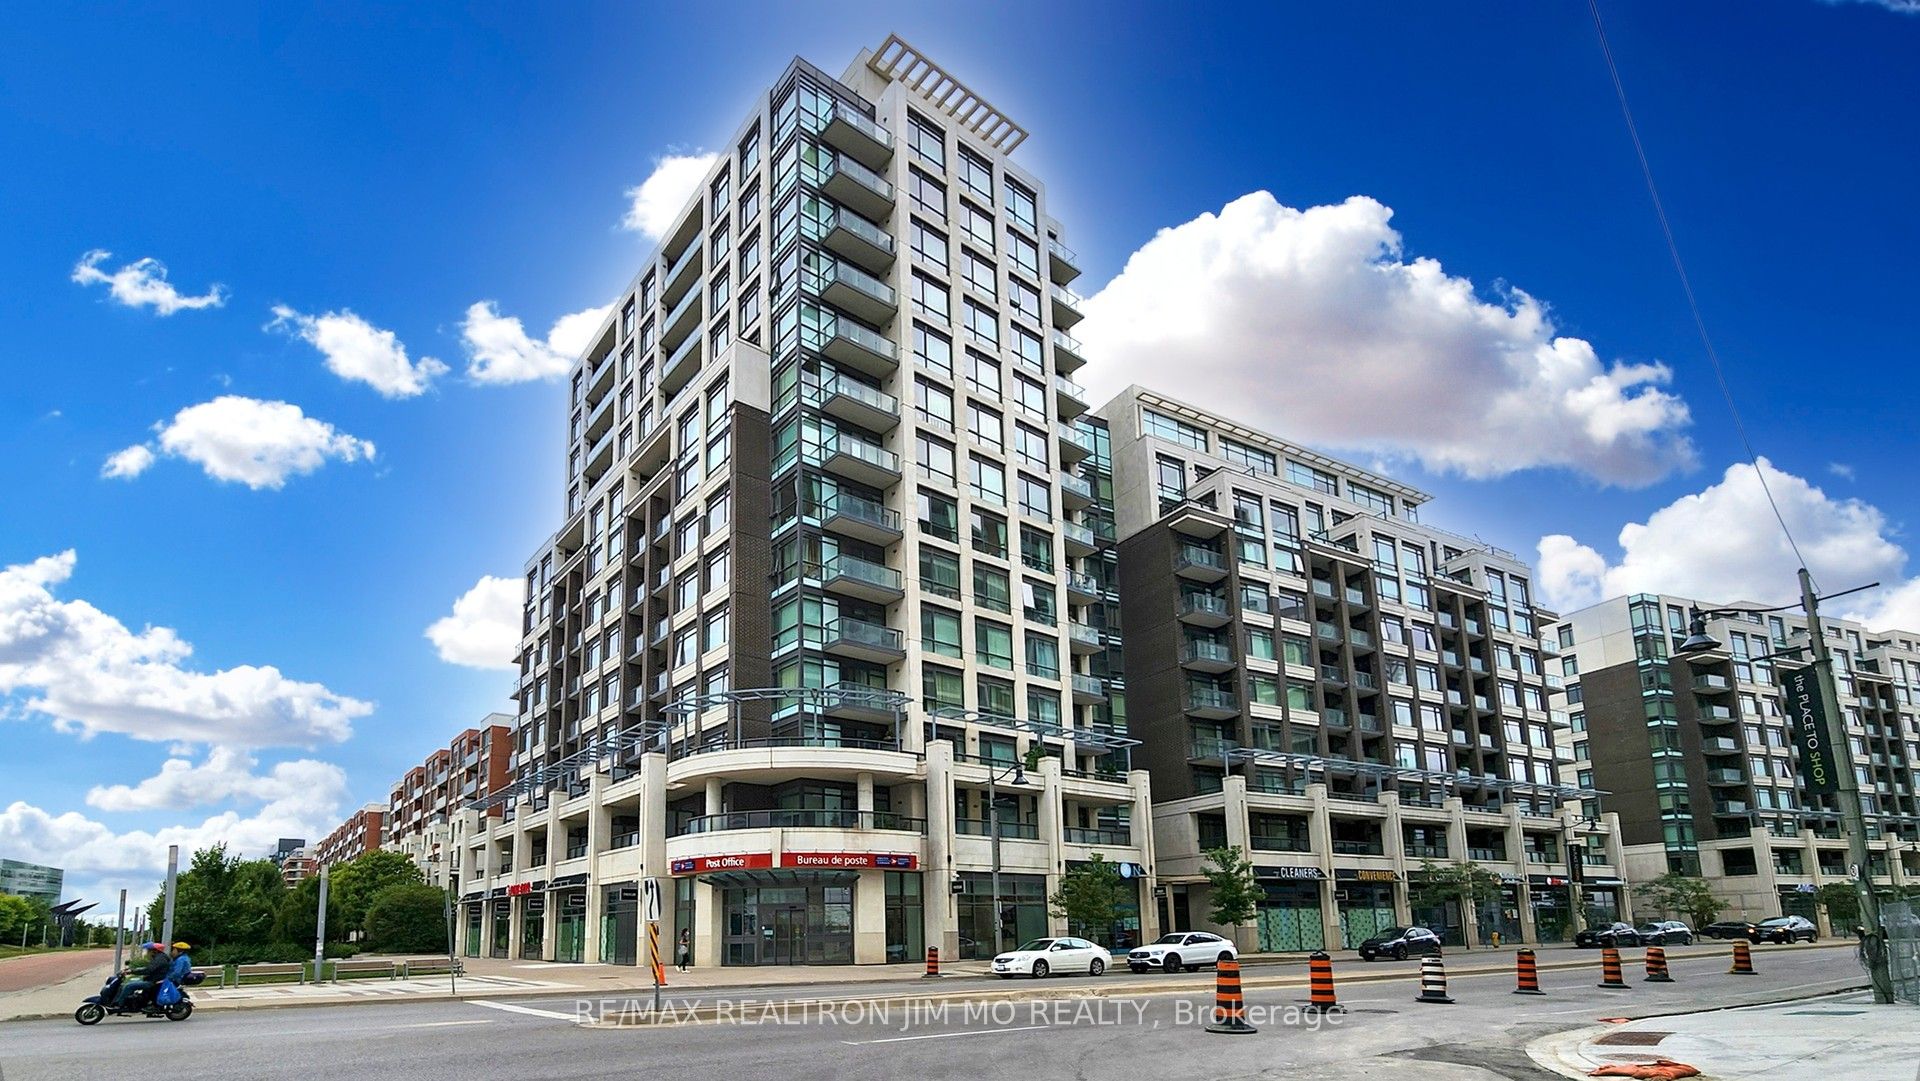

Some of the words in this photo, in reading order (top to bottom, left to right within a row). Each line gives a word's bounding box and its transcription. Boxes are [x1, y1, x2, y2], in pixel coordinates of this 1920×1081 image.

[1793, 674, 1804, 693] the
[1798, 694, 1815, 731] PLACE
[1806, 730, 1818, 750] TO
[1809, 751, 1826, 785] SHOP
[705, 859, 721, 868] Post
[721, 857, 745, 867] Office
[797, 855, 830, 865] Bureau
[831, 855, 842, 865] de
[844, 856, 868, 867] poste
[1280, 866, 1318, 879] CLEANERS
[1358, 870, 1397, 882] CONVENIENCE
